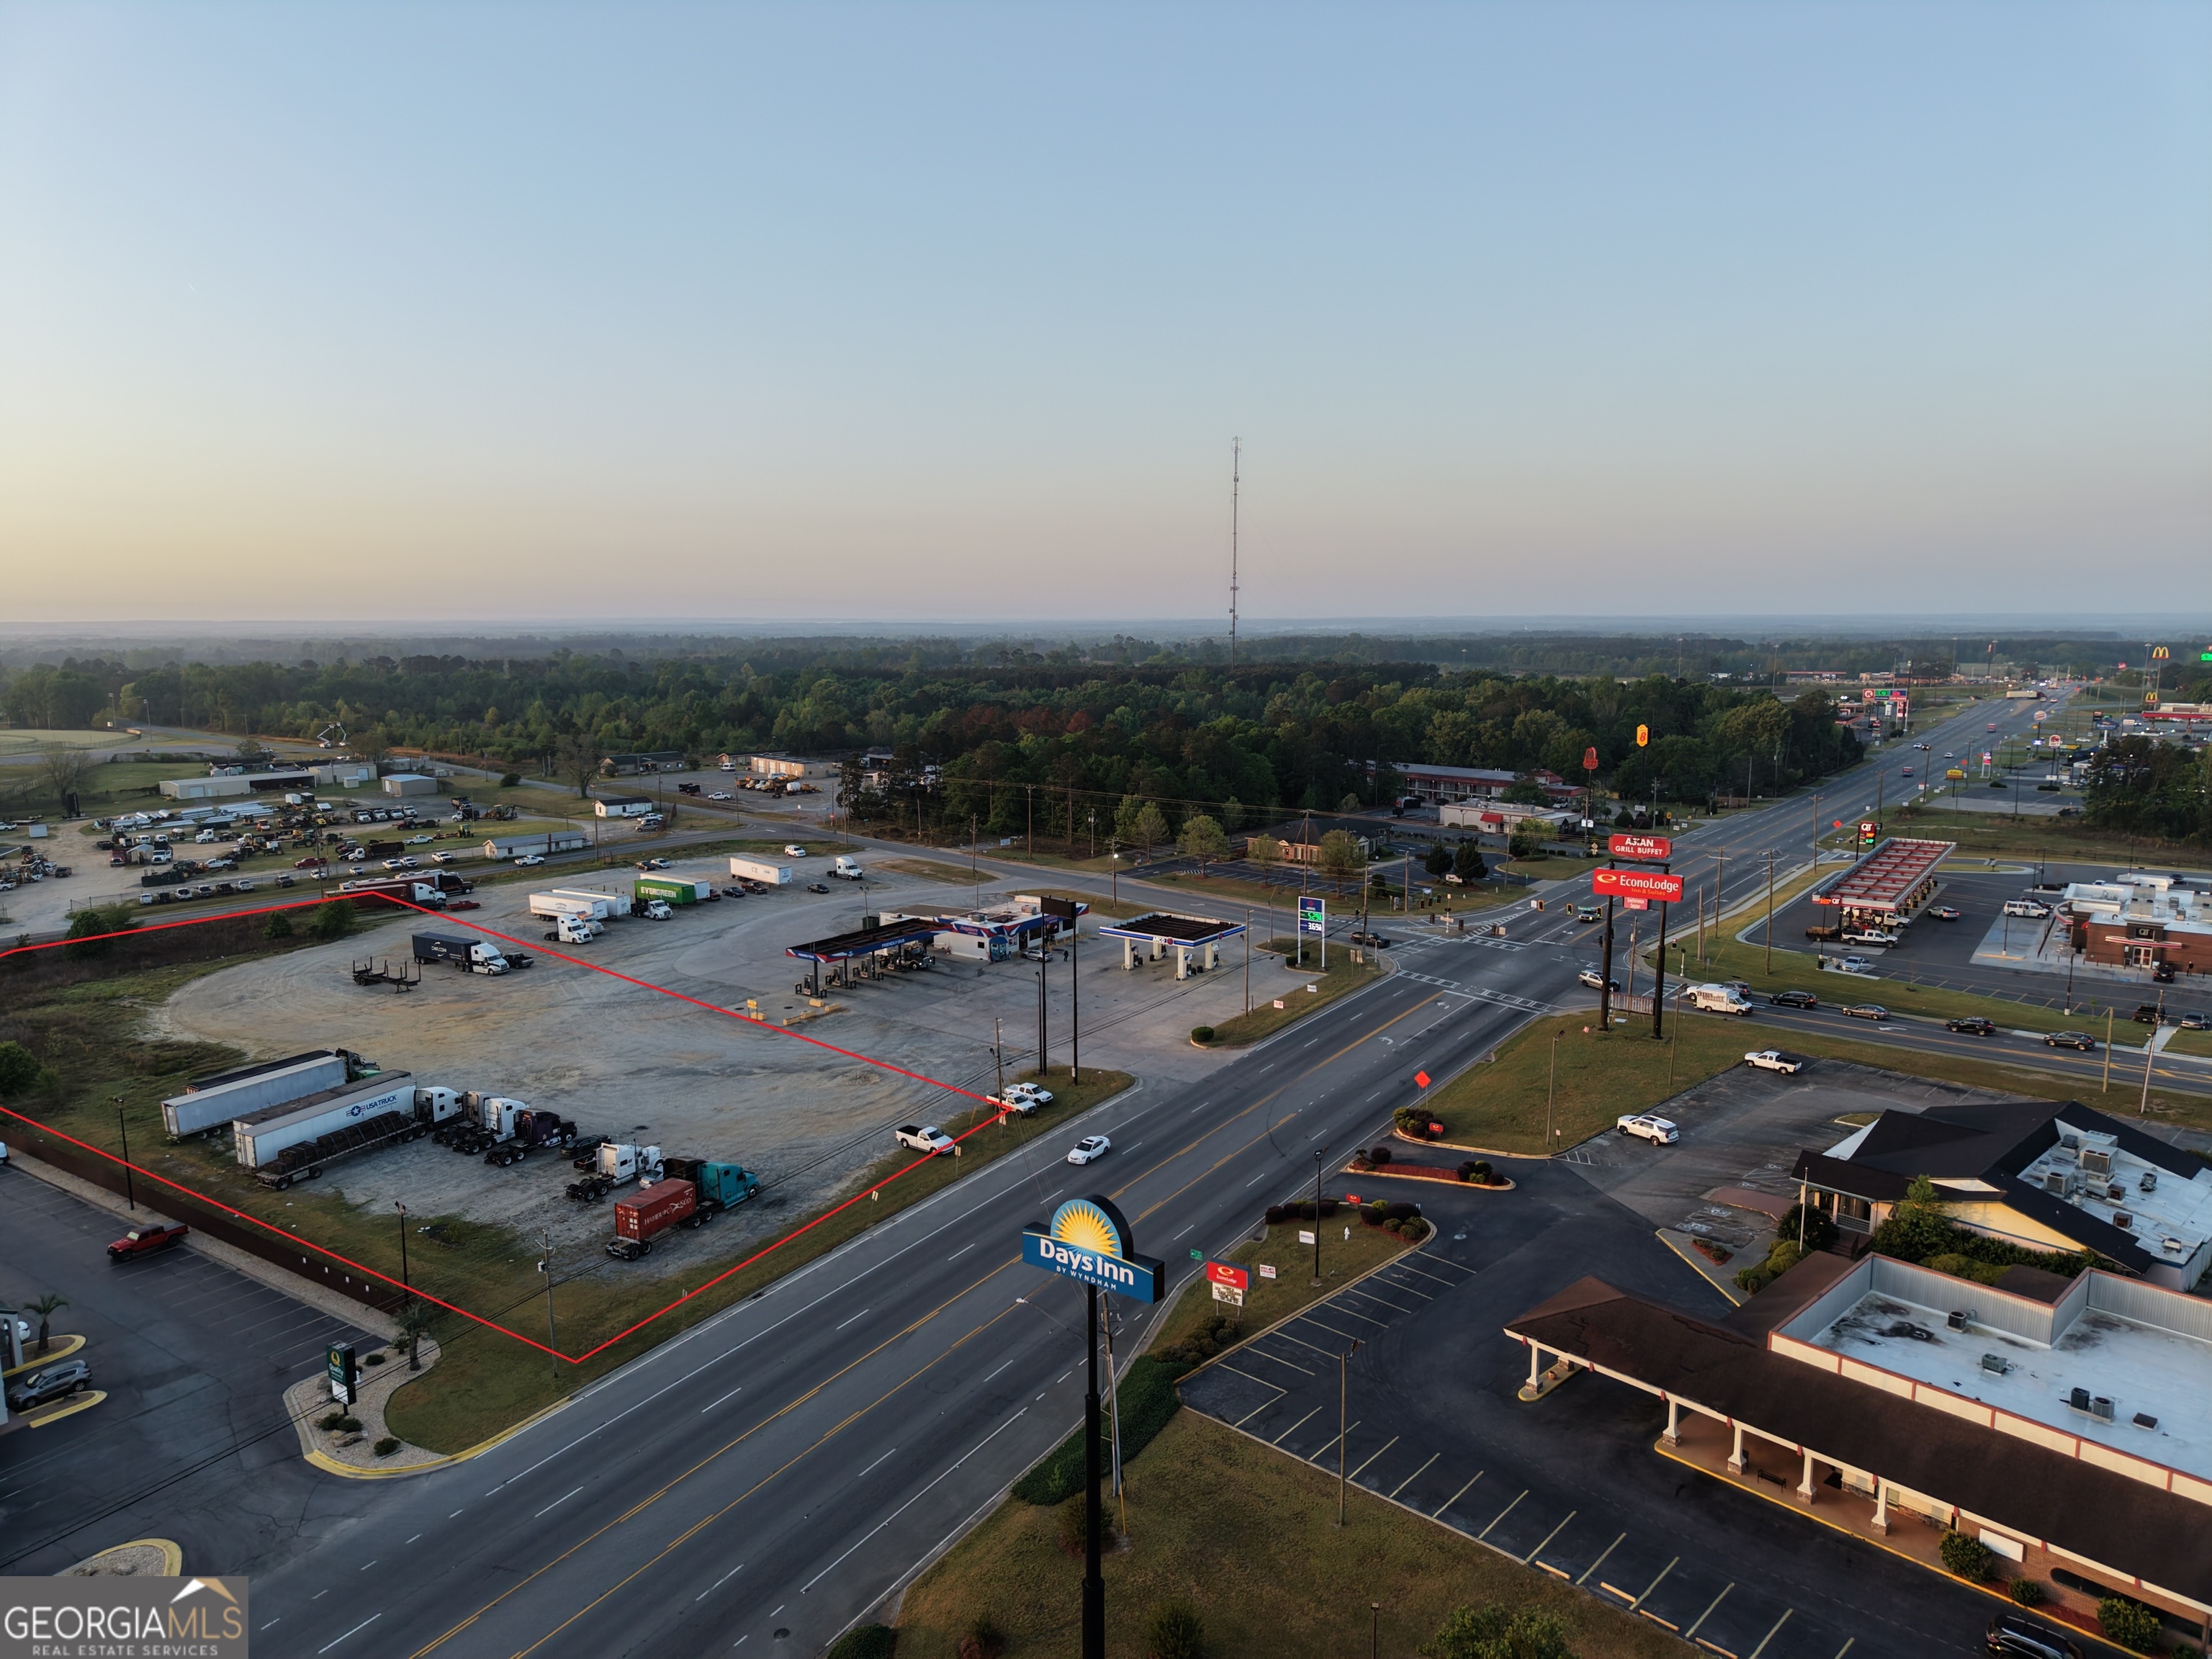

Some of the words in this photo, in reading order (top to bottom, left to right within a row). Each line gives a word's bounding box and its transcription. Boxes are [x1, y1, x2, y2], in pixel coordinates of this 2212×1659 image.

[1640, 732, 1647, 742] 8
[1637, 847, 1663, 855] BUFFET
[640, 886, 677, 898] EVERGREEN
[1620, 875, 1679, 893] EconoLodge
[366, 1101, 378, 1110] USA
[377, 1094, 397, 1106] TRUCK
[1040, 1238, 1093, 1272] Days
[1096, 1256, 1135, 1286] Inn
[1056, 1265, 1066, 1274] BY
[1070, 1269, 1117, 1291] WYNDHAM
